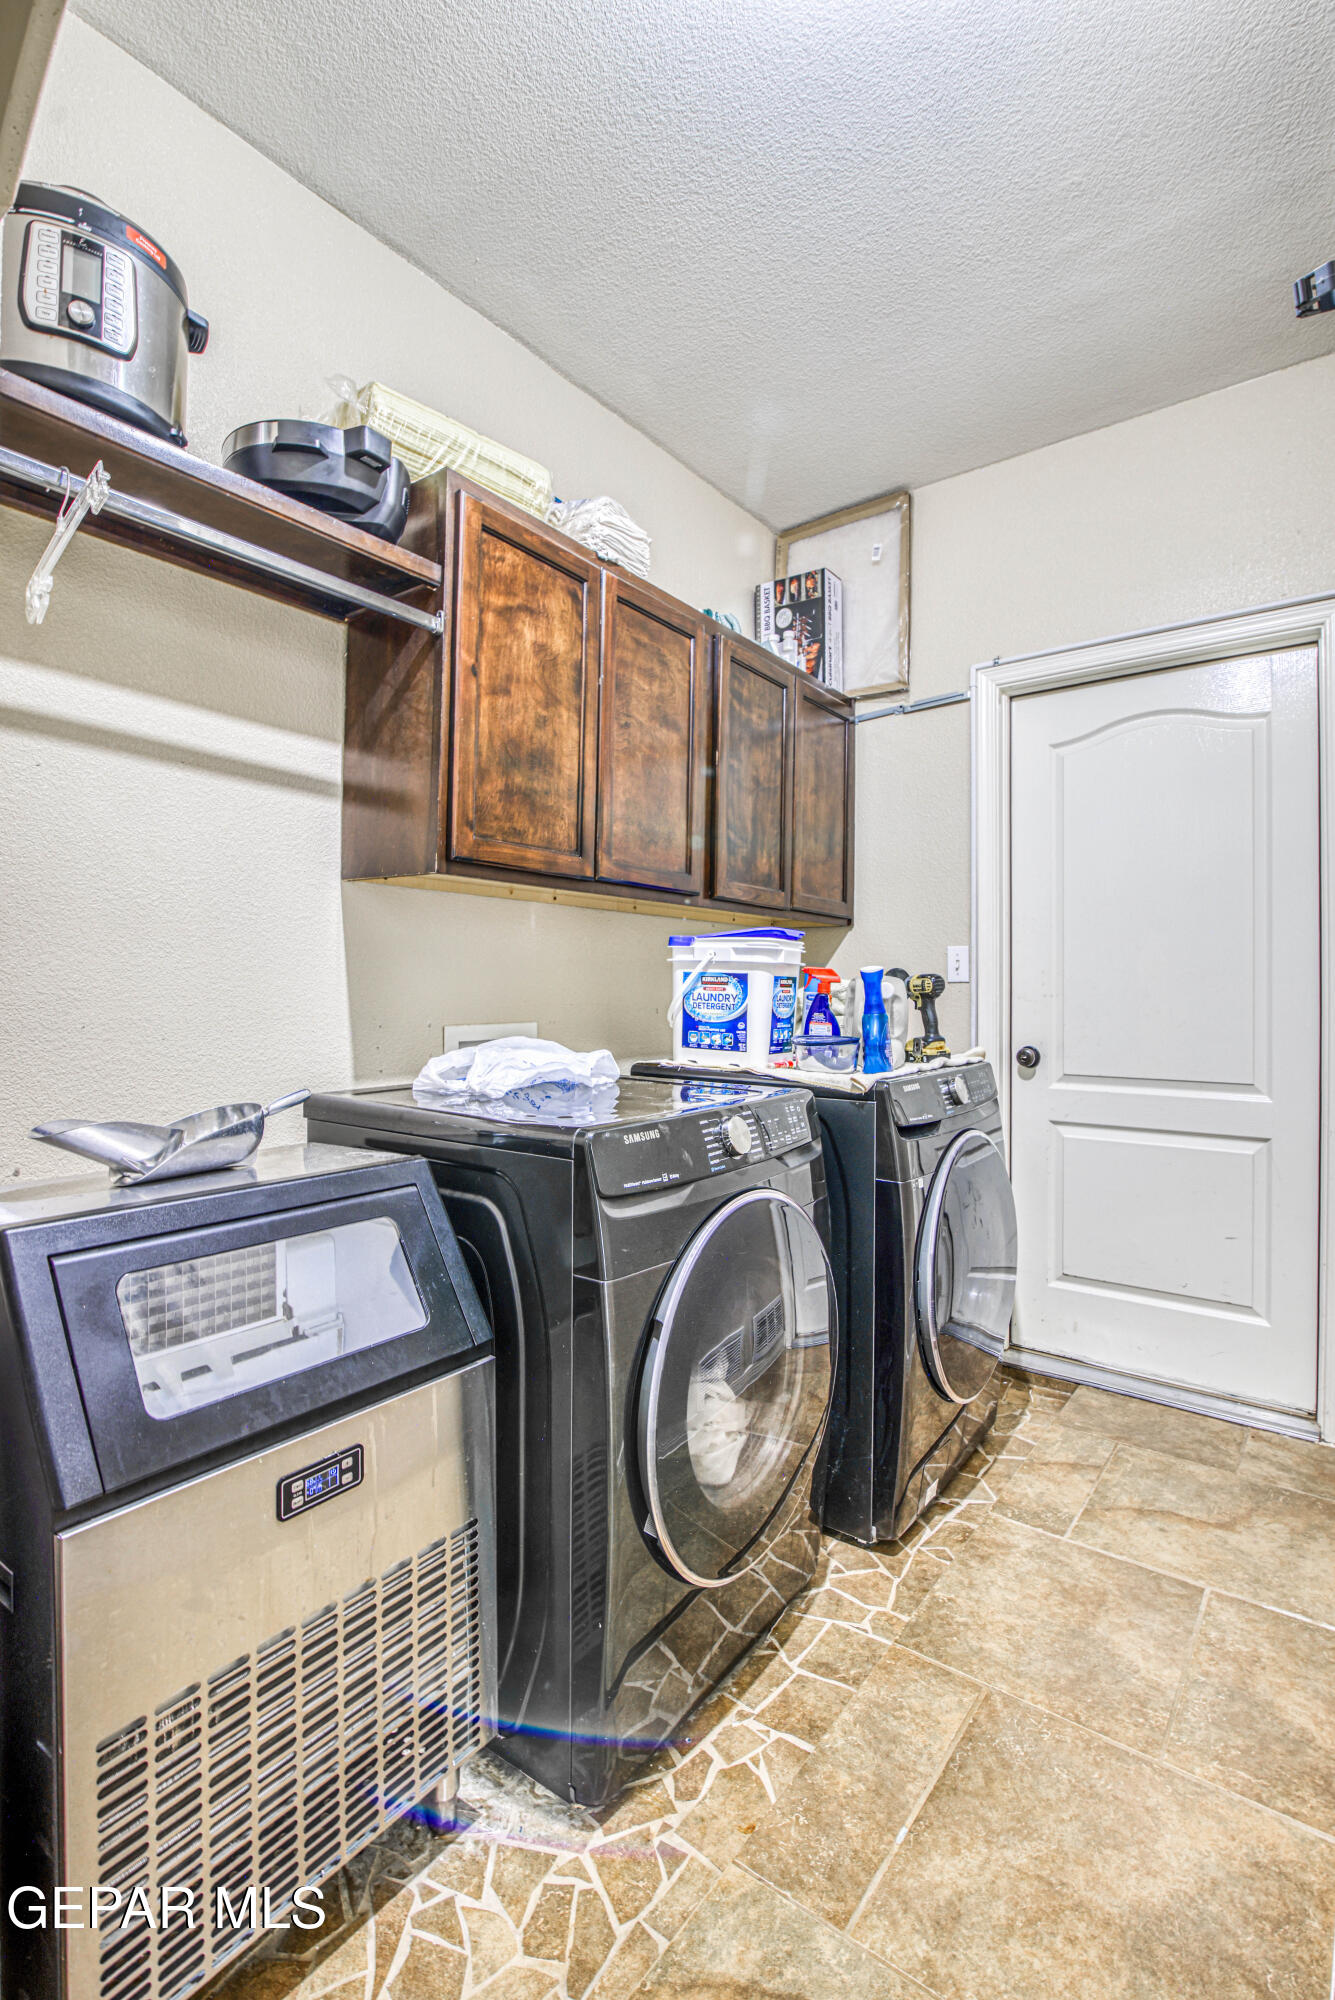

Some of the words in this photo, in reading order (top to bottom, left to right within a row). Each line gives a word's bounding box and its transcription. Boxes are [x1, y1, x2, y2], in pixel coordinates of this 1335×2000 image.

[691, 992, 738, 1003] LAUNDRY
[692, 1002, 737, 1011] DETERGENT
[623, 1129, 661, 1145] SAMSUNG
